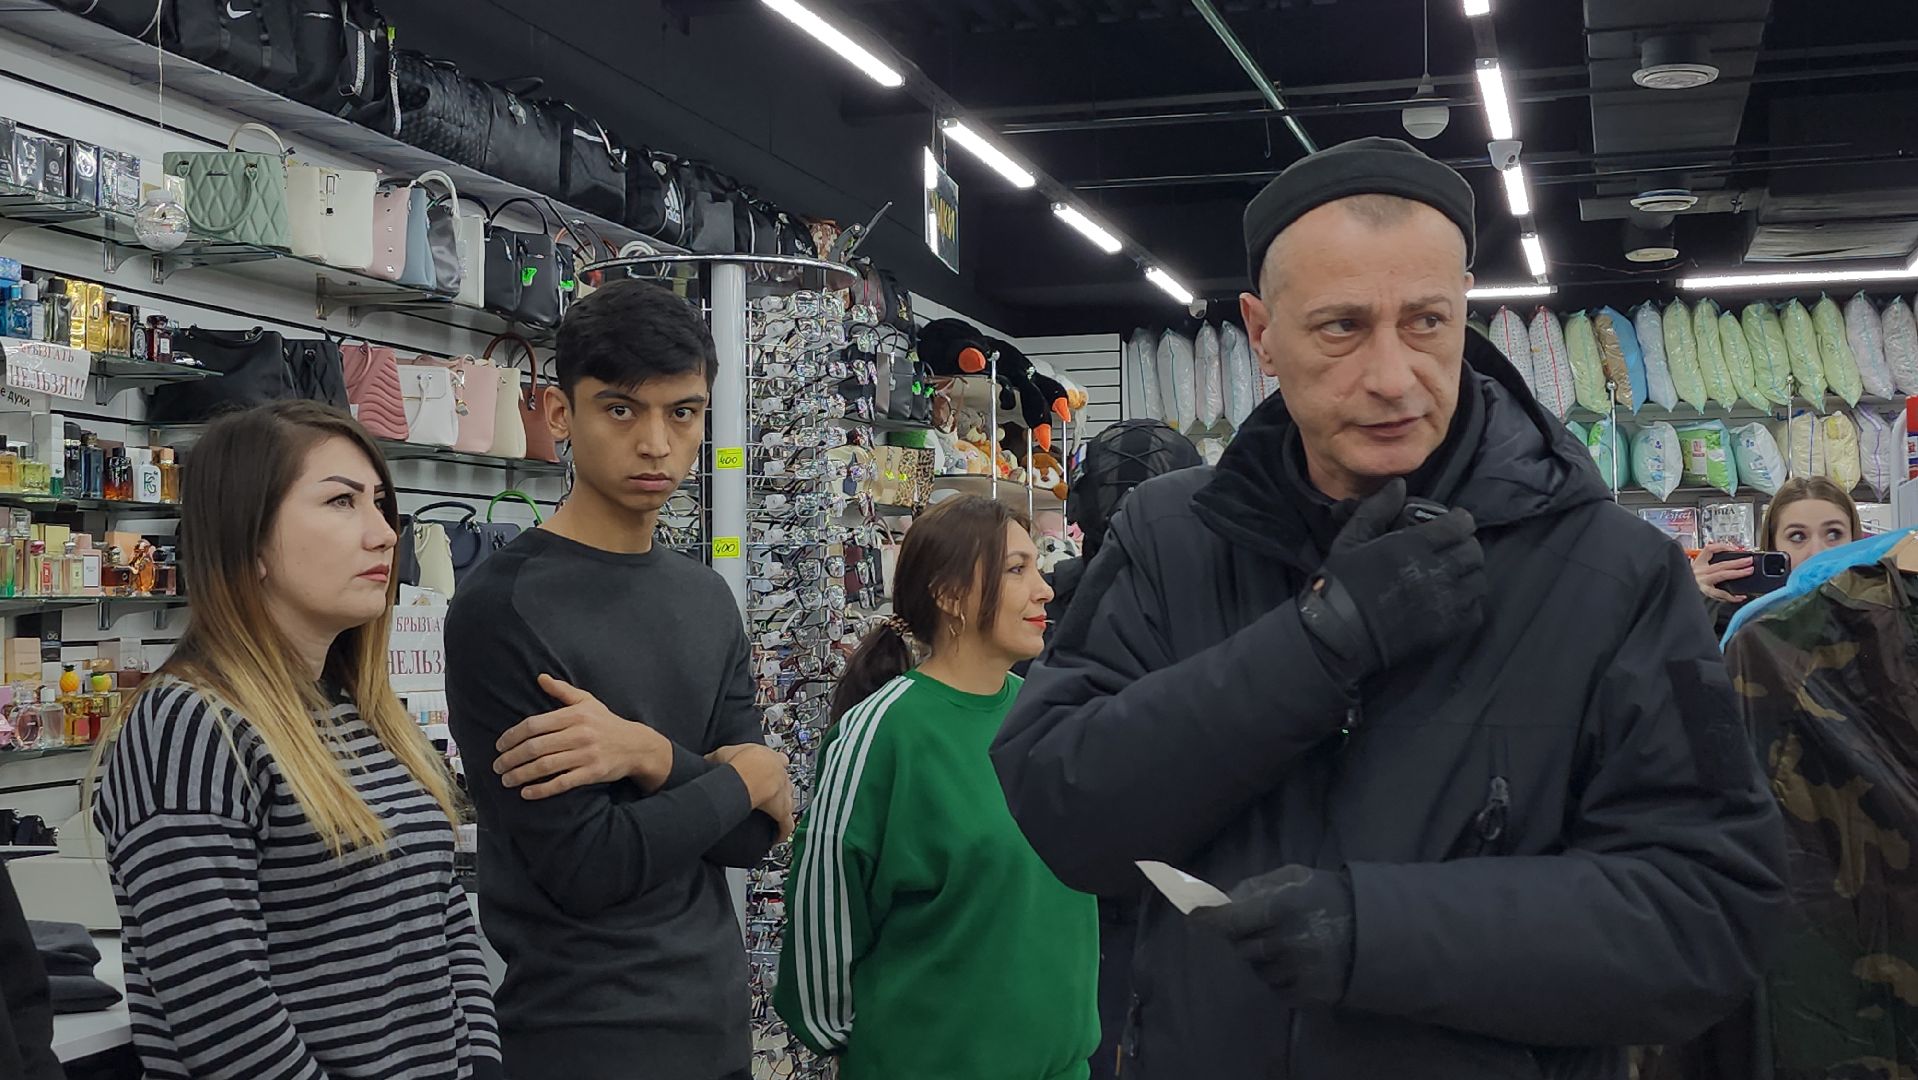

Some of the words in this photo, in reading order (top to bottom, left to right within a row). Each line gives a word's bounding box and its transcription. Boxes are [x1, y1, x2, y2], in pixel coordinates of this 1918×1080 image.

[9, 364, 85, 399] НЕЛЬЗЯ!!!
[7, 391, 31, 407] духи
[719, 456, 738, 465] 400
[715, 543, 736, 554] 400
[396, 616, 445, 633] БРЫЗГА
[388, 650, 446, 675] НЕЛЬЗ
